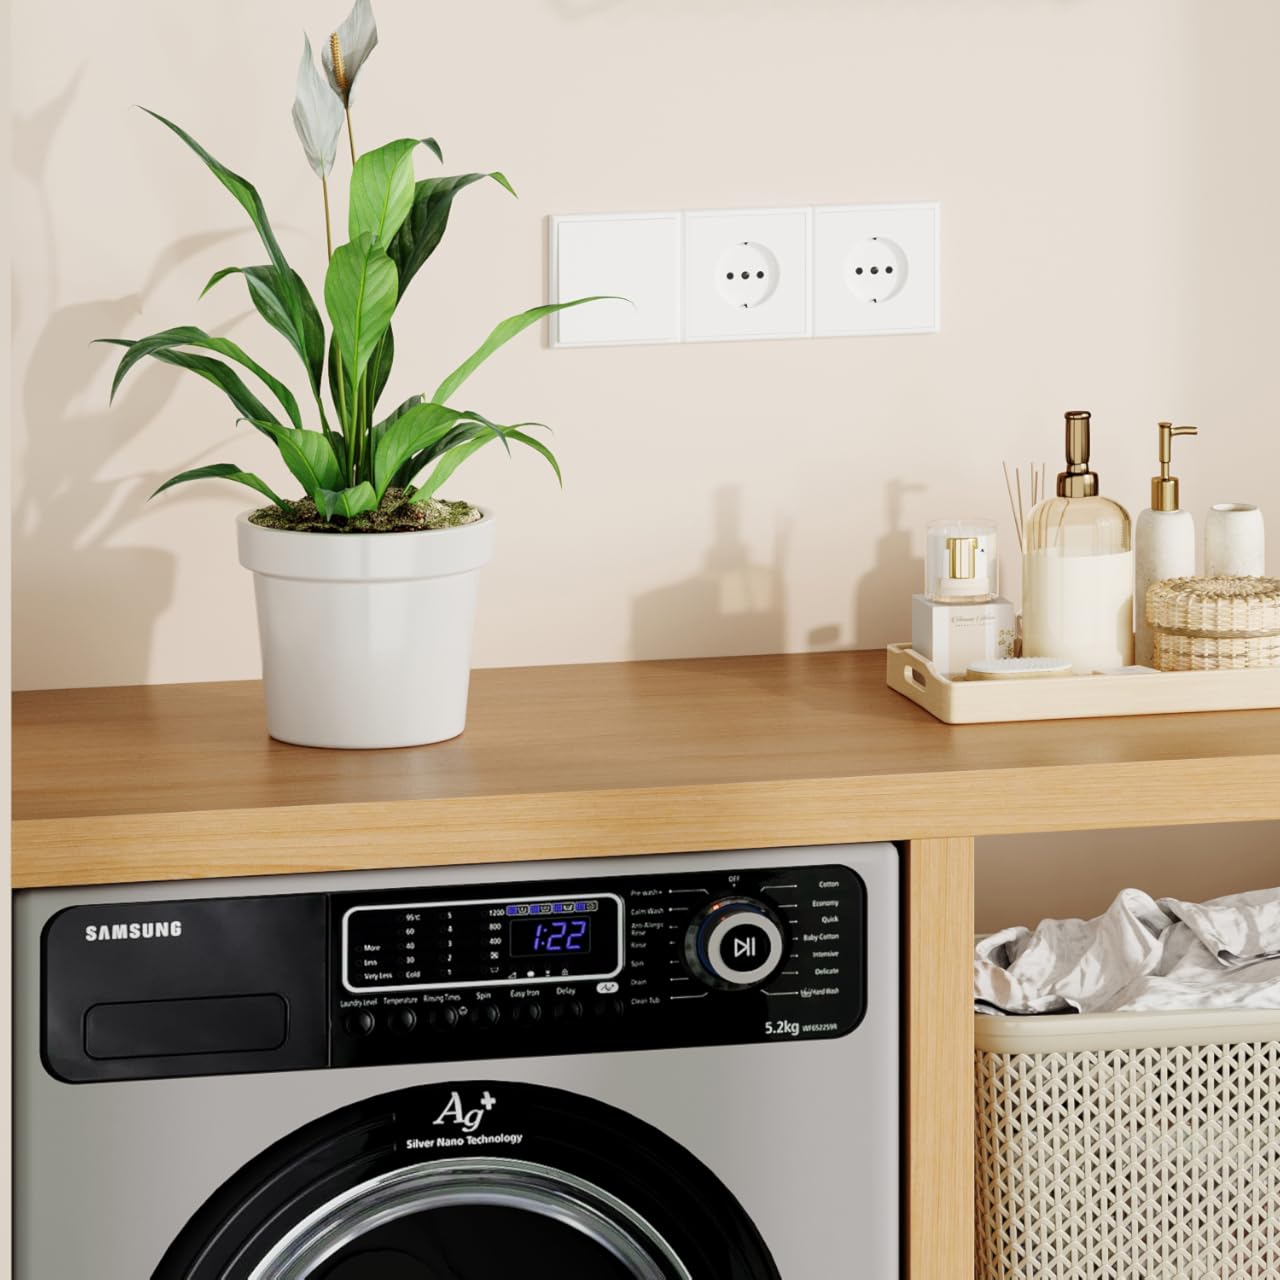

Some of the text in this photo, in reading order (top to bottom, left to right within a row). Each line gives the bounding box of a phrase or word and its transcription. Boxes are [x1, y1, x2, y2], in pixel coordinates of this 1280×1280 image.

[85, 920, 182, 941] SAMSUNG
[534, 921, 587, 950] 1:22
[476, 992, 491, 1000] Spin
[510, 990, 525, 998] Easy
[556, 987, 575, 995] Delay
[765, 1020, 799, 1036] 5.2kg
[406, 1132, 523, 1150] Silver Nano Technology
